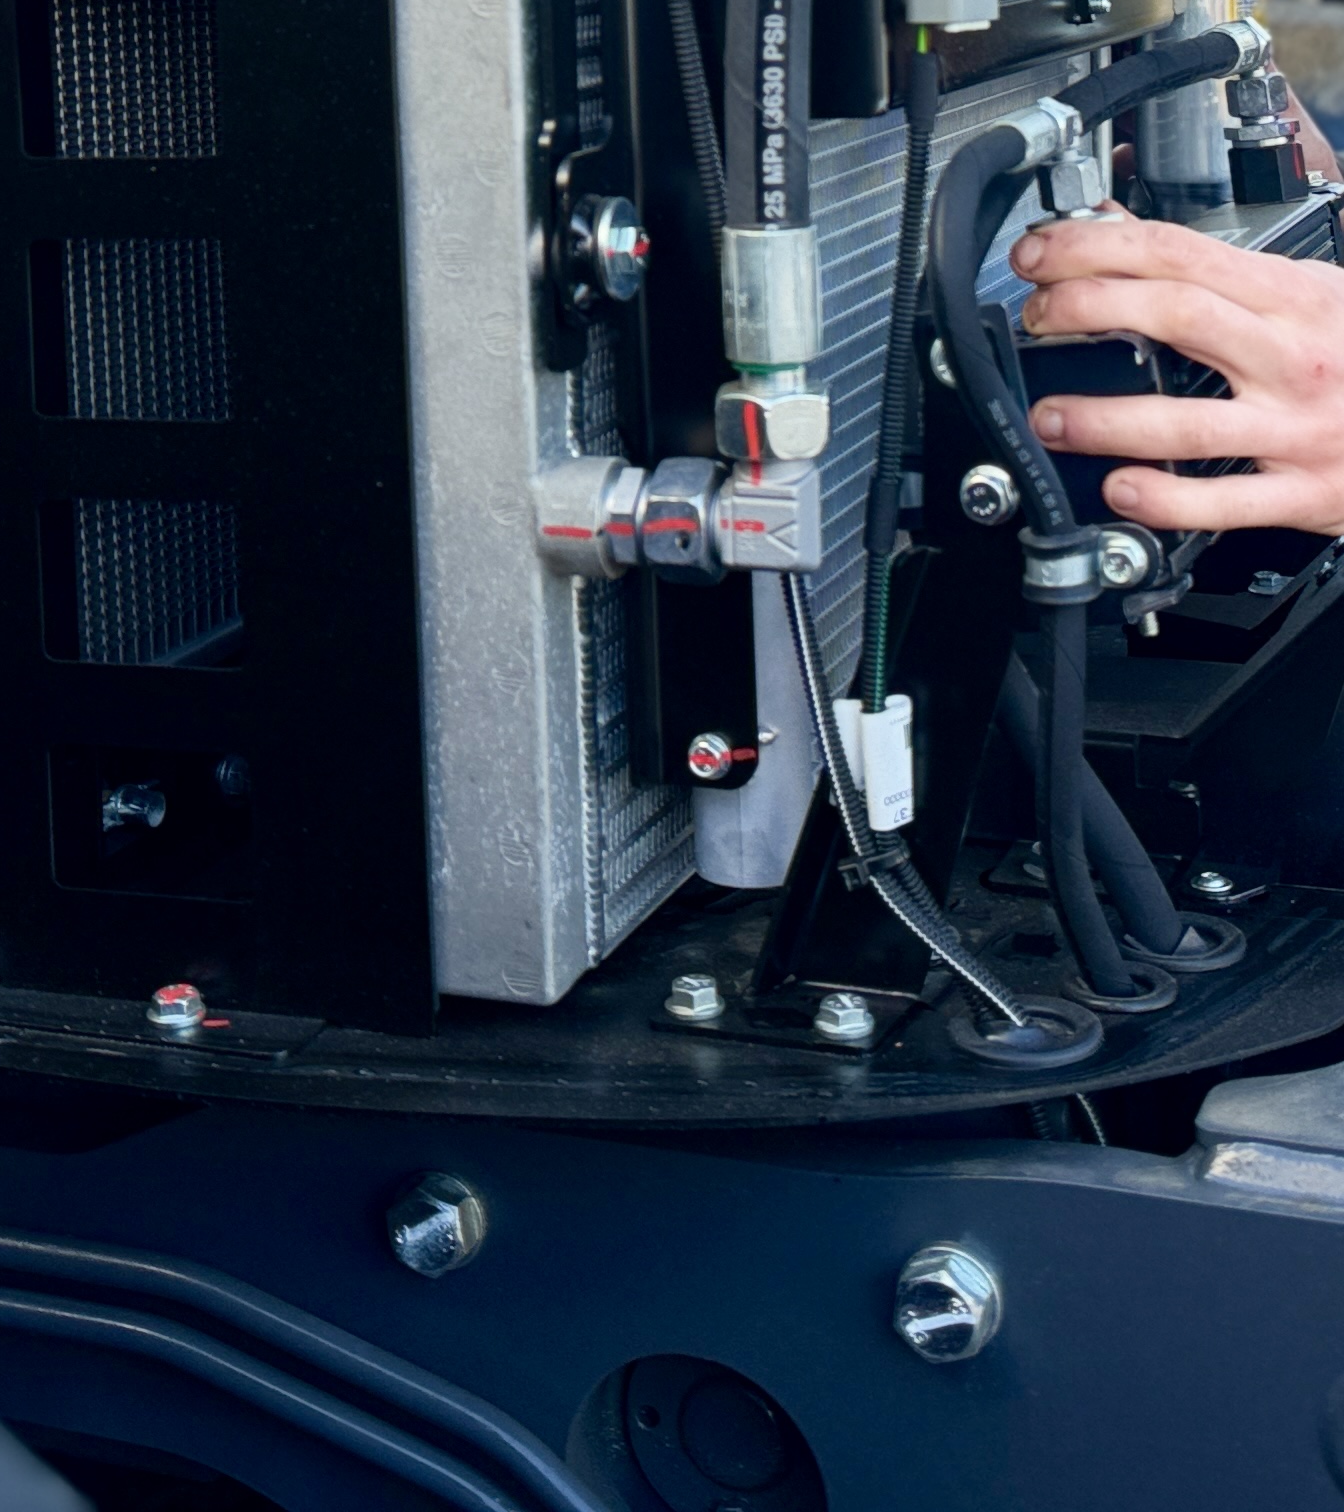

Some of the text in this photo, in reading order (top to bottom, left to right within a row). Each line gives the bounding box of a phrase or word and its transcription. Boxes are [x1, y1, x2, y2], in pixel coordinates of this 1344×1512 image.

[762, 14, 786, 61] PSI)
[762, 65, 785, 131] (3630
[762, 133, 785, 185] MPa
[764, 190, 786, 218] 25
